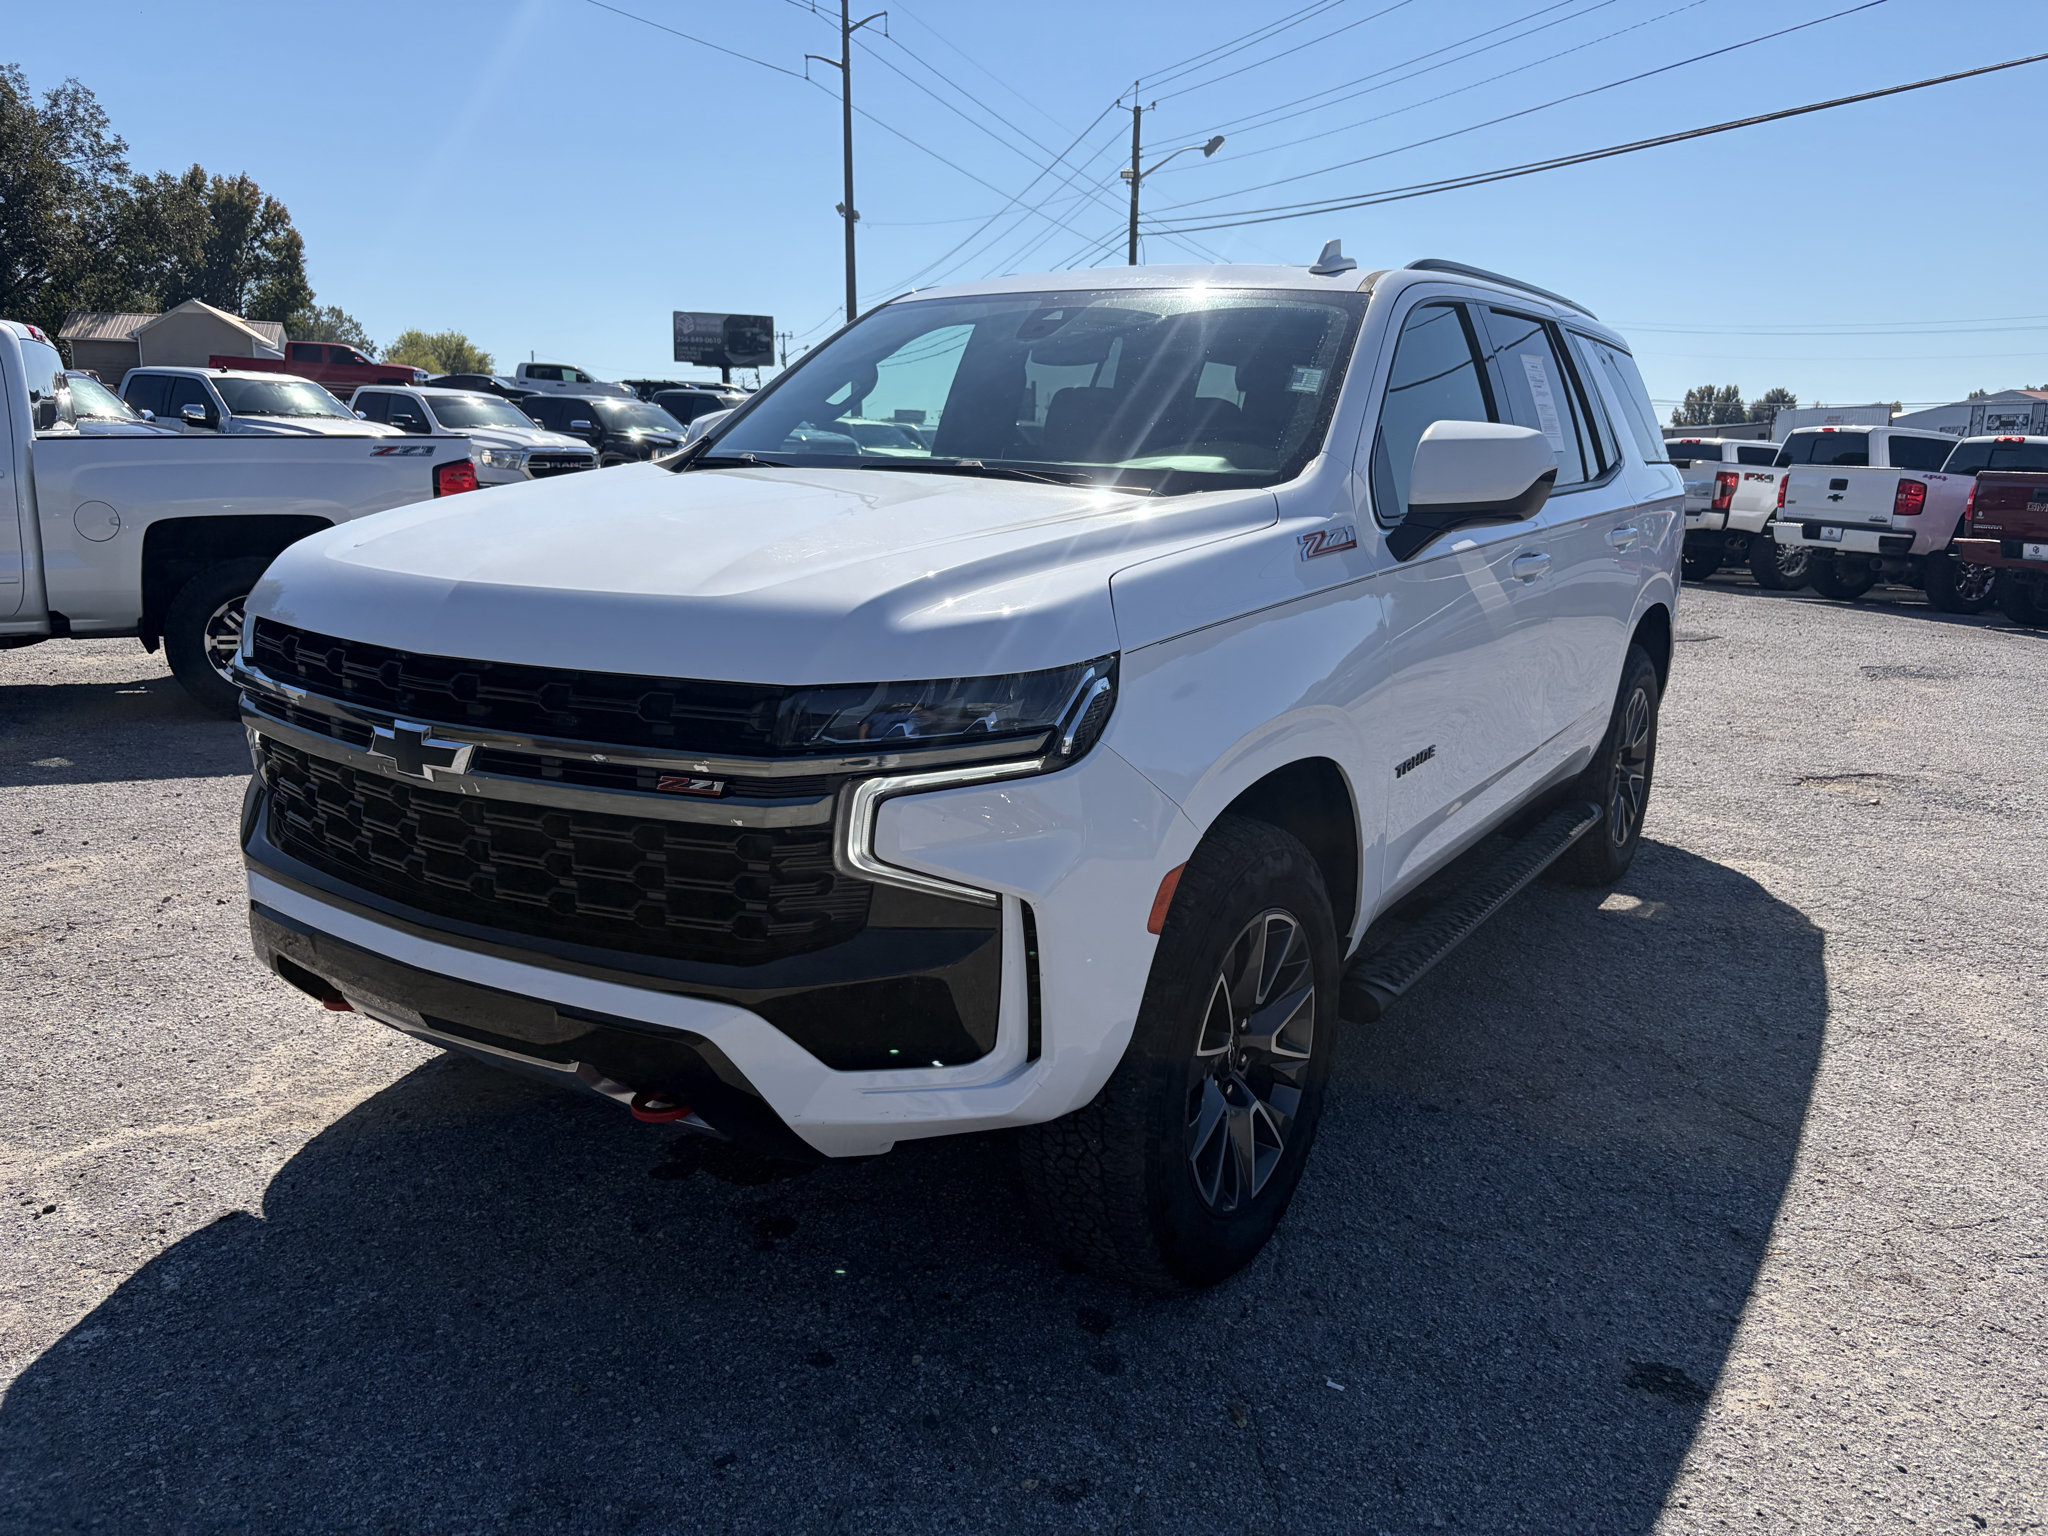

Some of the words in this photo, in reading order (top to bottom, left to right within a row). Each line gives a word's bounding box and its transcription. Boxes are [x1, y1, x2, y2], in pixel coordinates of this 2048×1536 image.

[369, 445, 437, 457] Z71
[1743, 472, 1775, 483] FX4
[2025, 501, 2048, 512] GM
[1296, 525, 1358, 562] Z71
[1394, 743, 1437, 779] TAHOE
[656, 775, 725, 796] Z71
